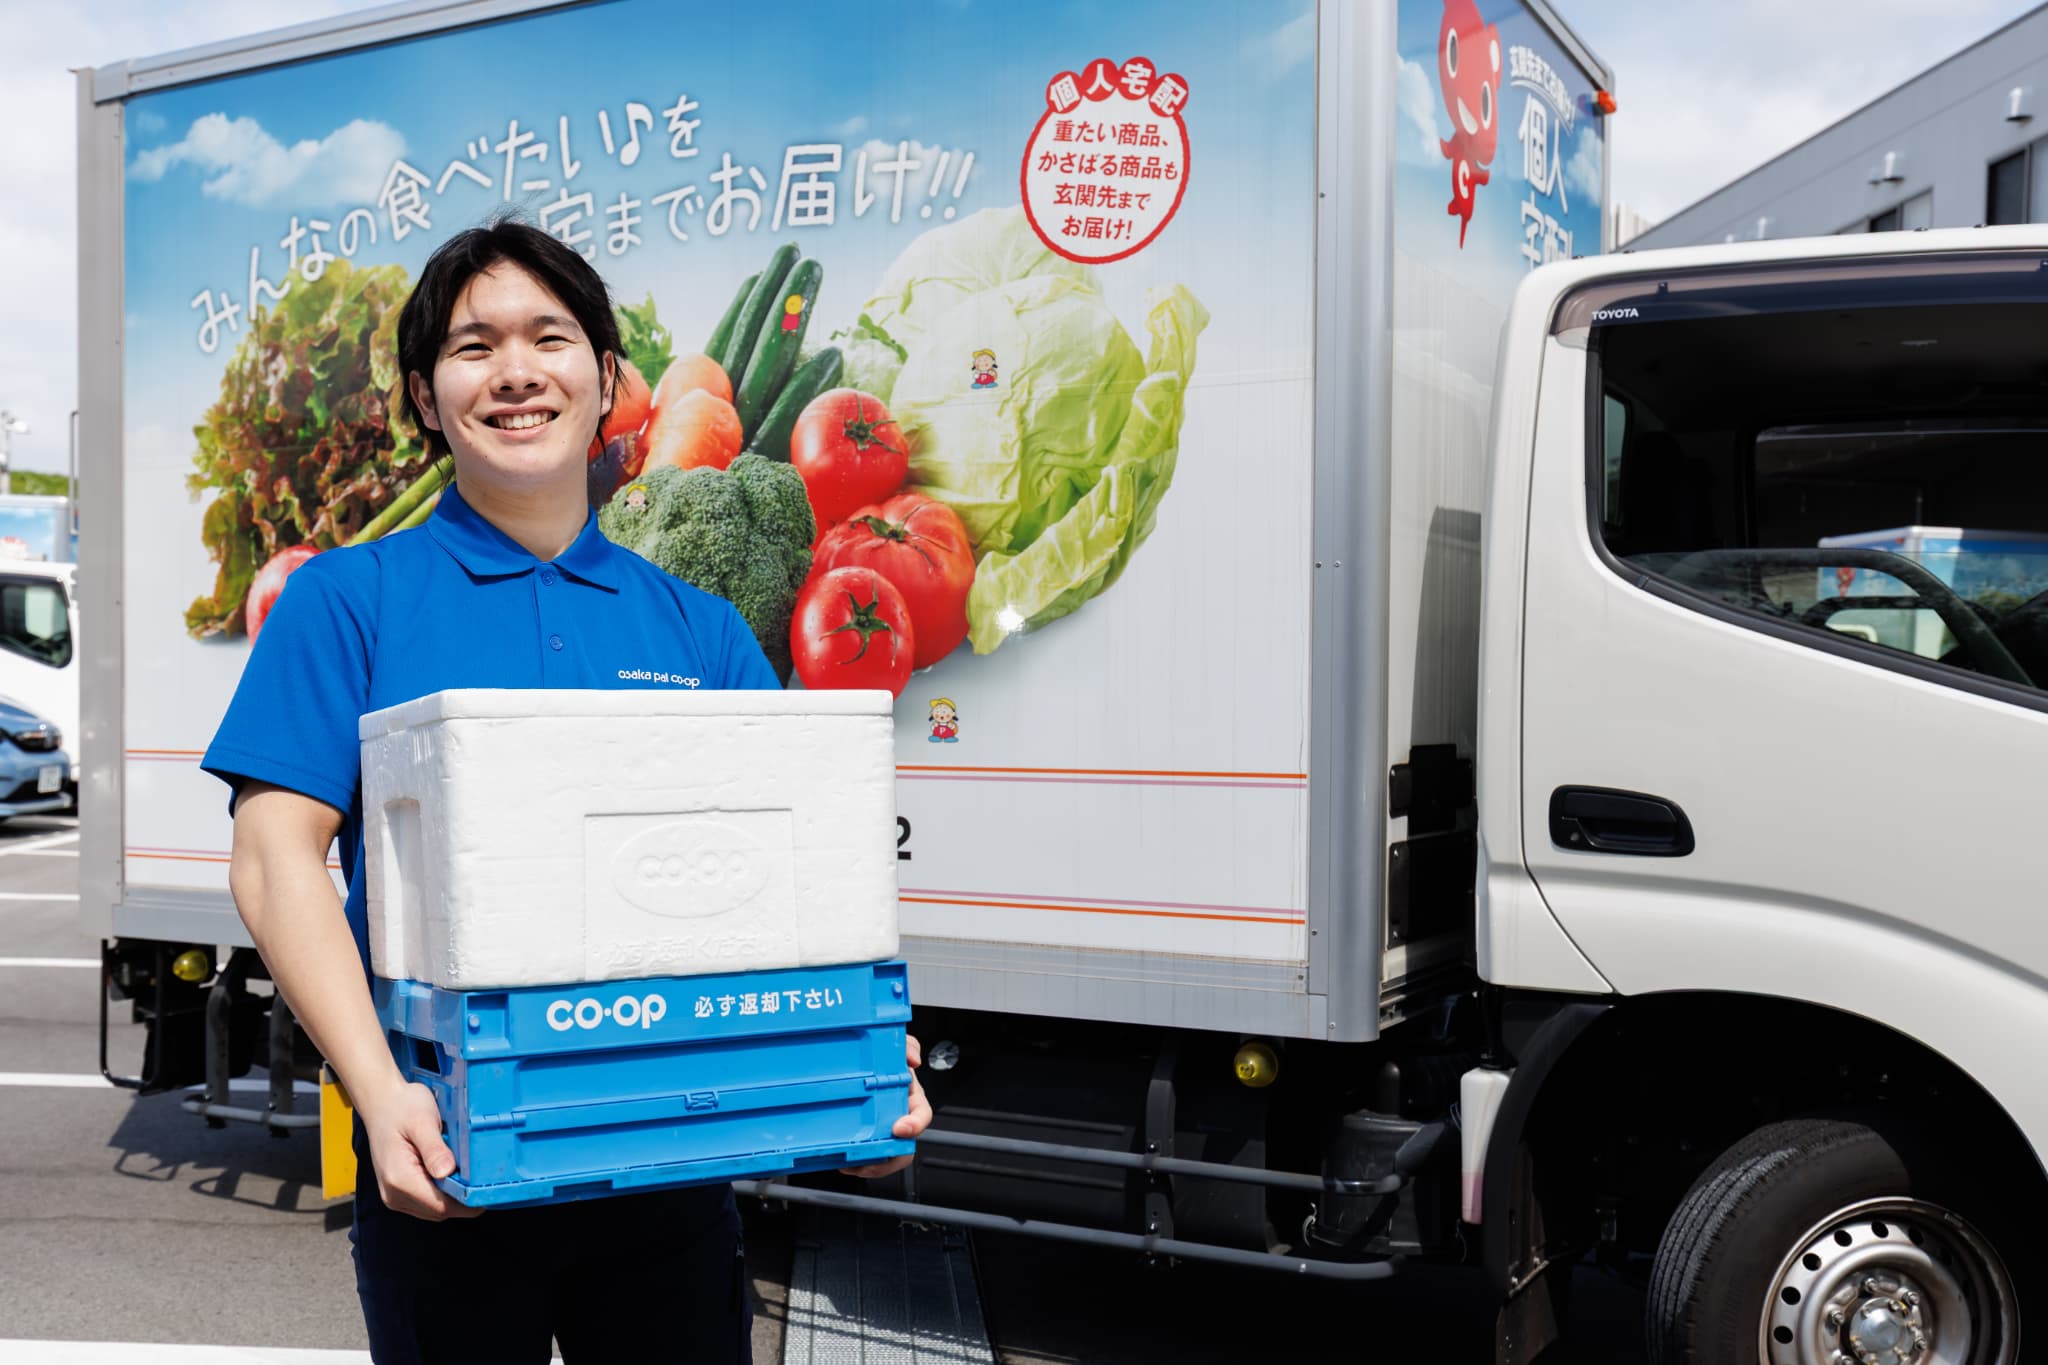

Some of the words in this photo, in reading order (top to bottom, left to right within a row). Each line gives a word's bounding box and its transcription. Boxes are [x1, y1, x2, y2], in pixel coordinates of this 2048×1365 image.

[1049, 62, 1188, 116] 個人宅配
[1053, 119, 1169, 148] 重たい商品、
[1037, 150, 1179, 180] かさばる商品も
[1053, 183, 1152, 211] 玄関先まで
[1061, 215, 1134, 240] お届け!
[1592, 307, 1640, 320] TOYOTA
[618, 668, 652, 680] osaka
[653, 671, 669, 683] pal
[693, 987, 843, 1019] 必ず返却下さい
